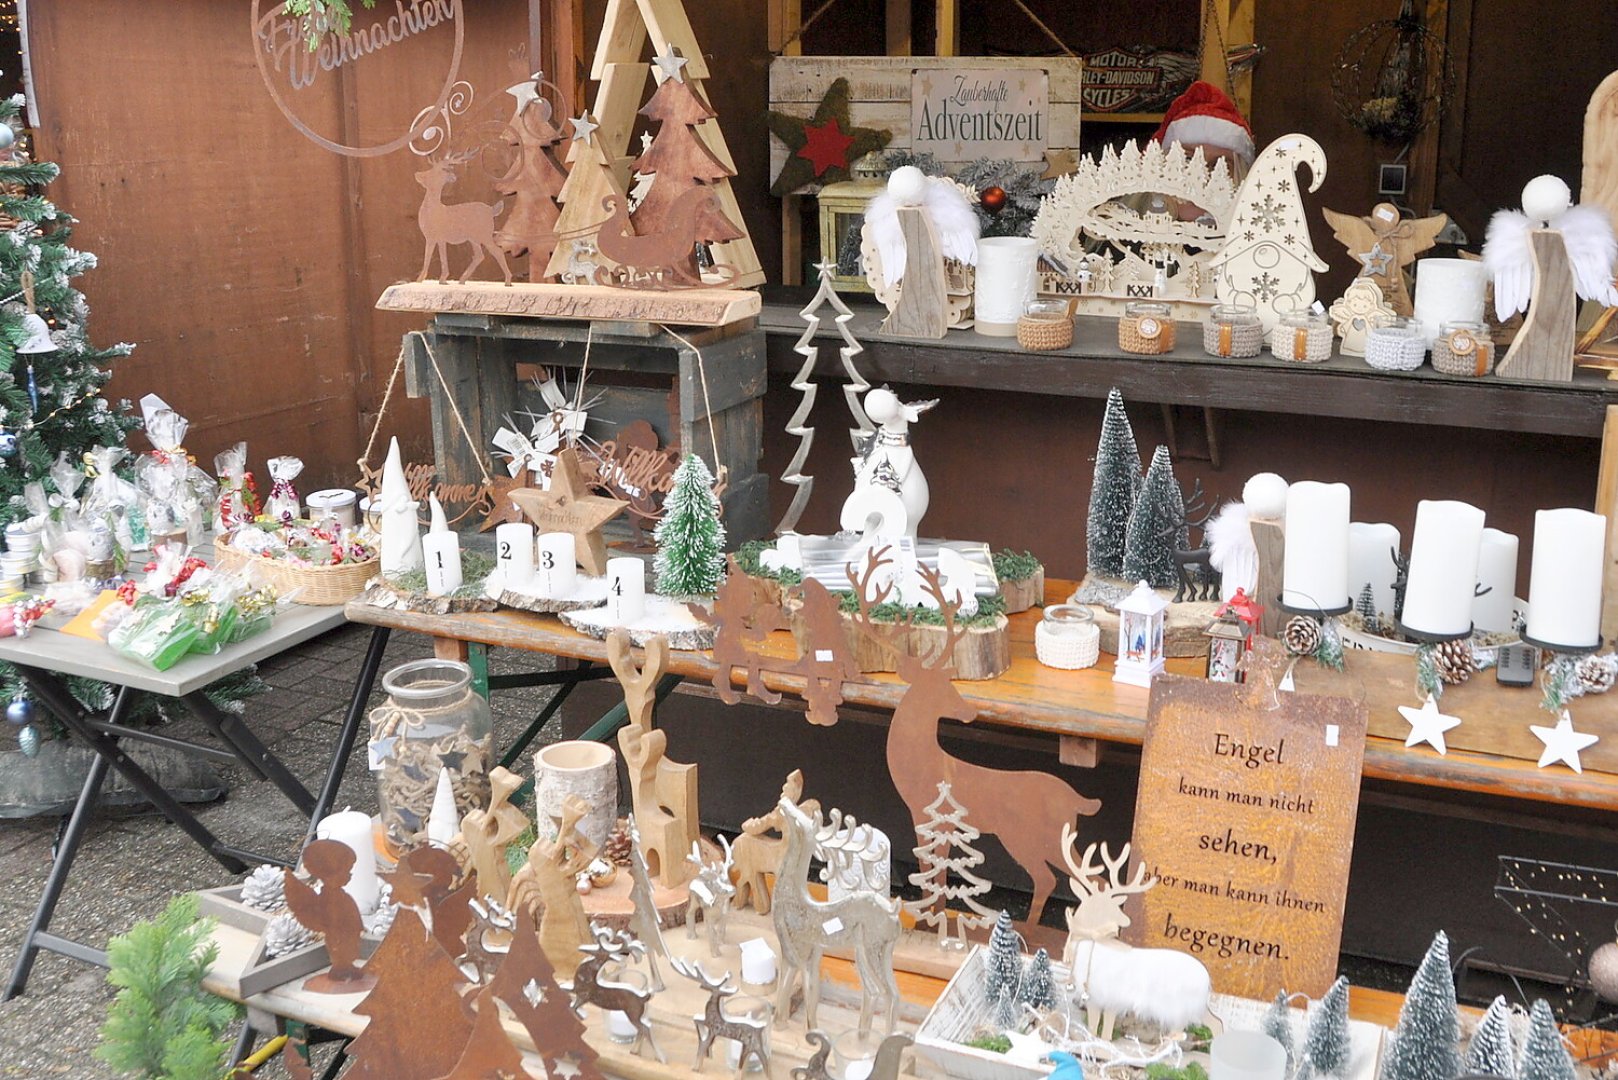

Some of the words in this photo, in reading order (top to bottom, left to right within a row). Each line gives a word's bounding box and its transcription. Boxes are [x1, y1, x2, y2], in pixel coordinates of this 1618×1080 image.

[1089, 50, 1138, 67] MOTOR
[1082, 70, 1155, 85] RLEY-DAVIDSON
[950, 75, 1009, 111] Zauberhafte
[1083, 87, 1131, 108] CYCLES
[916, 98, 1043, 142] Adventszeit
[435, 551, 444, 570] 1
[500, 541, 512, 560] 2
[542, 551, 555, 569] 3
[611, 576, 623, 596] 4
[1215, 733, 1284, 769] Engel
[1179, 777, 1220, 800] kann
[1226, 791, 1262, 807] man
[1269, 795, 1314, 815] nicht
[1199, 828, 1278, 865] sehen,
[1184, 877, 1219, 897] man
[1226, 880, 1269, 904] kann
[1275, 890, 1325, 914] ihnen
[1164, 912, 1290, 960] begegnen.
